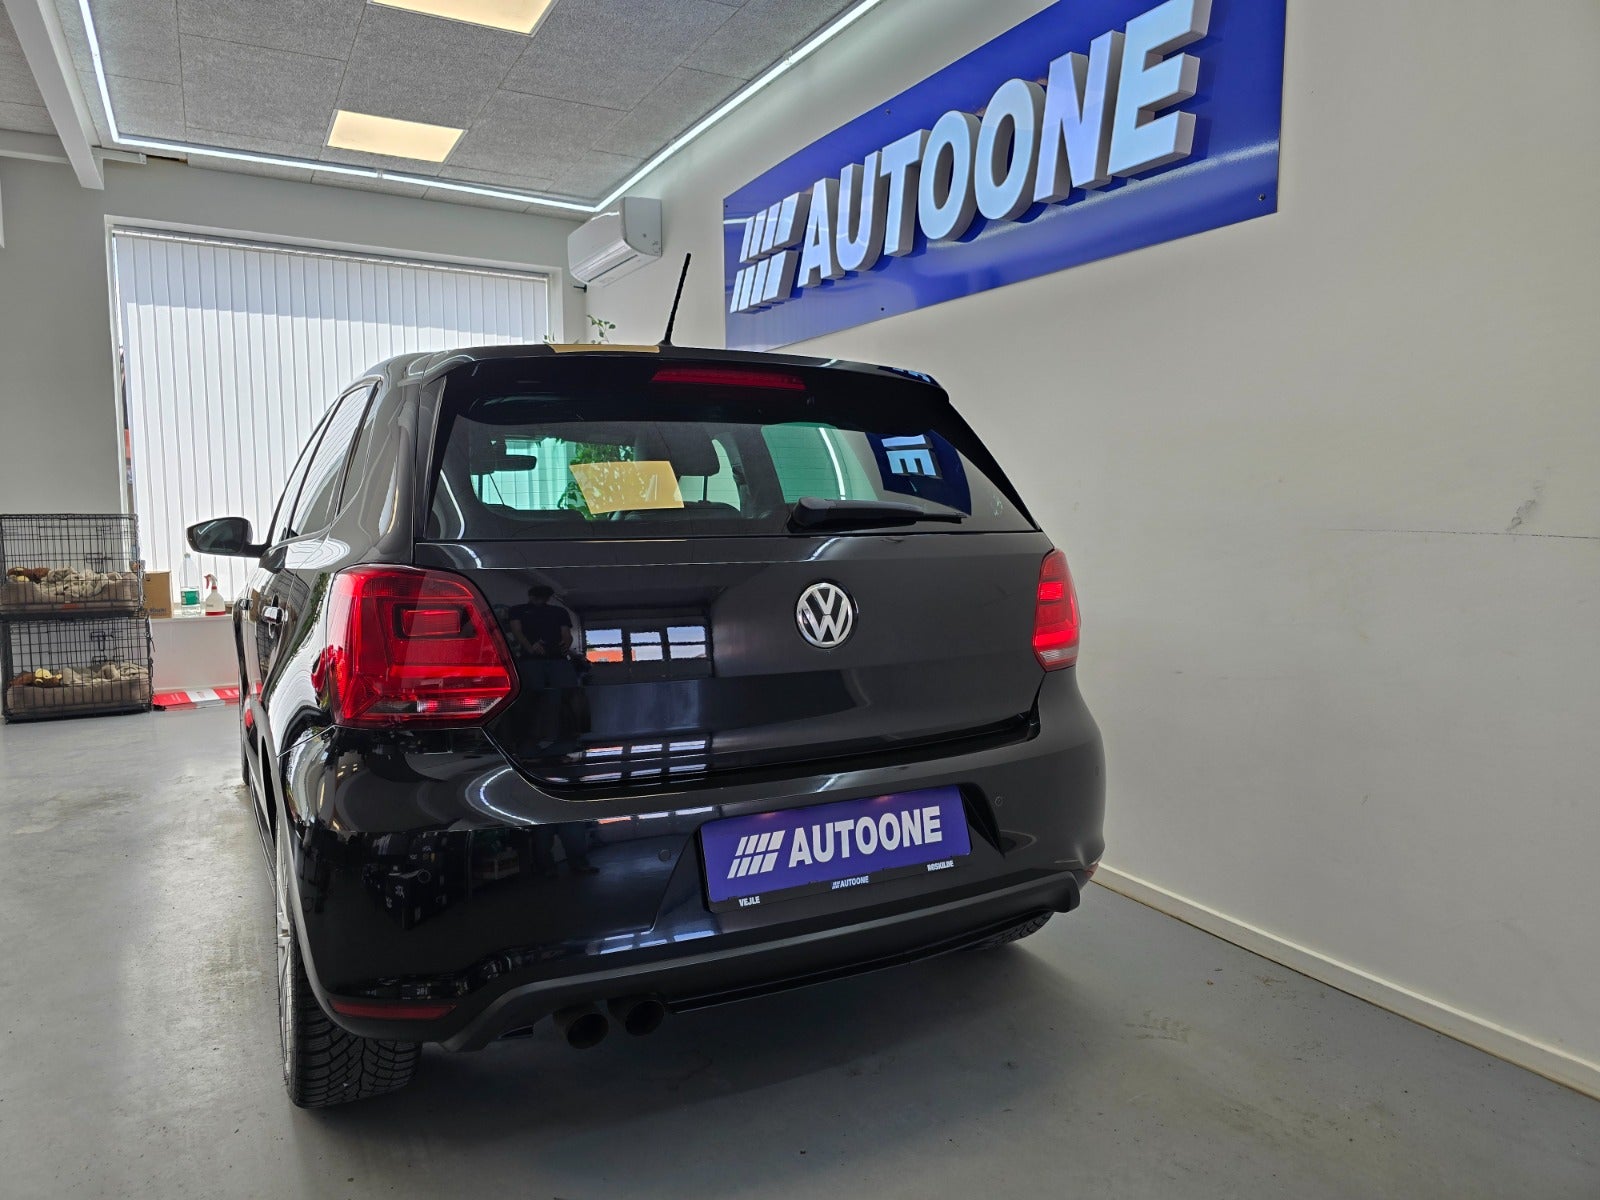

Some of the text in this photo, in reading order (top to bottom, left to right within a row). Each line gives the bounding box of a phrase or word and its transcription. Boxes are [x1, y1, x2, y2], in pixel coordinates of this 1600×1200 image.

[798, 0, 1210, 287] AUTOONE
[797, 583, 853, 648] VW
[788, 806, 942, 867] AUTOONE
[739, 896, 760, 907] VEJLE
[840, 876, 869, 888] AUTOONE
